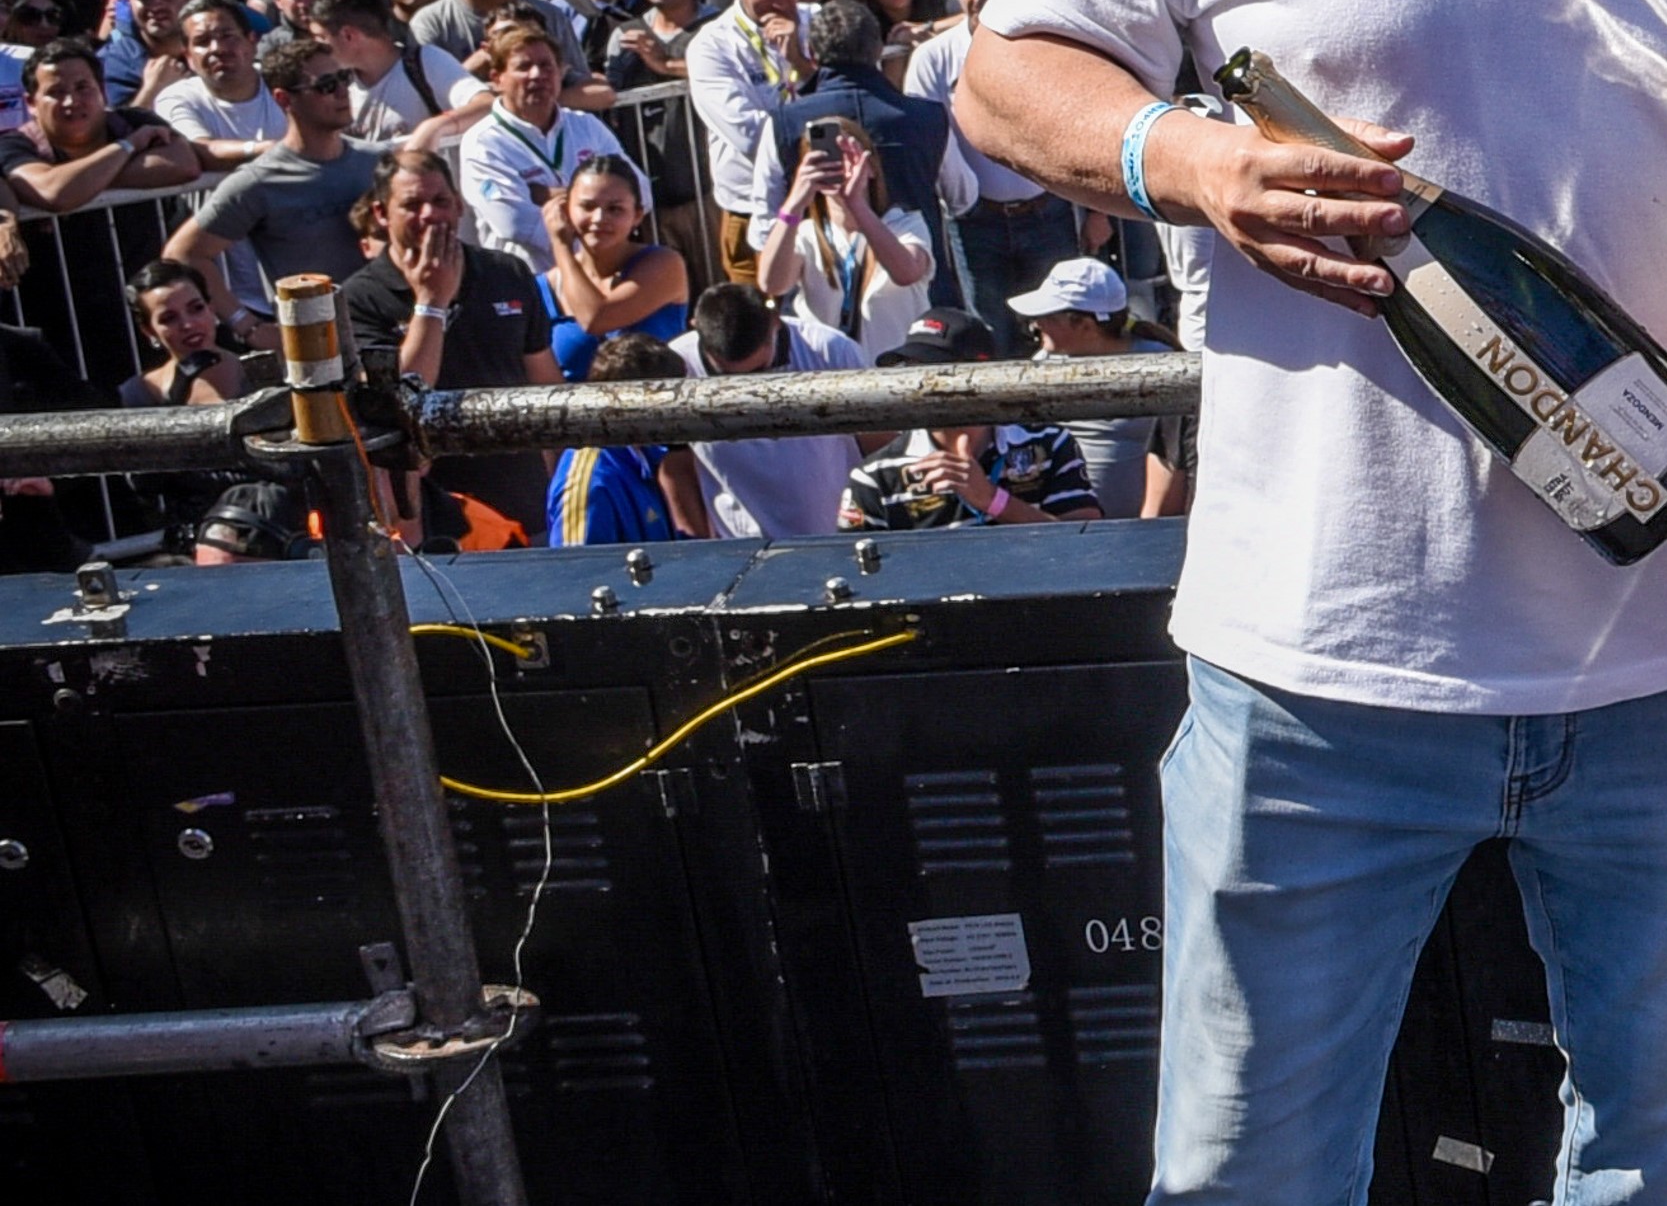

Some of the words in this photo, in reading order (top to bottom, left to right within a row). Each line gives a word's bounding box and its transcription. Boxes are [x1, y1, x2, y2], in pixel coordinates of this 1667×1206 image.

[1476, 335, 1660, 512] CHANDON
[1622, 388, 1665, 431] MENDOZA
[1086, 916, 1161, 953] 048
